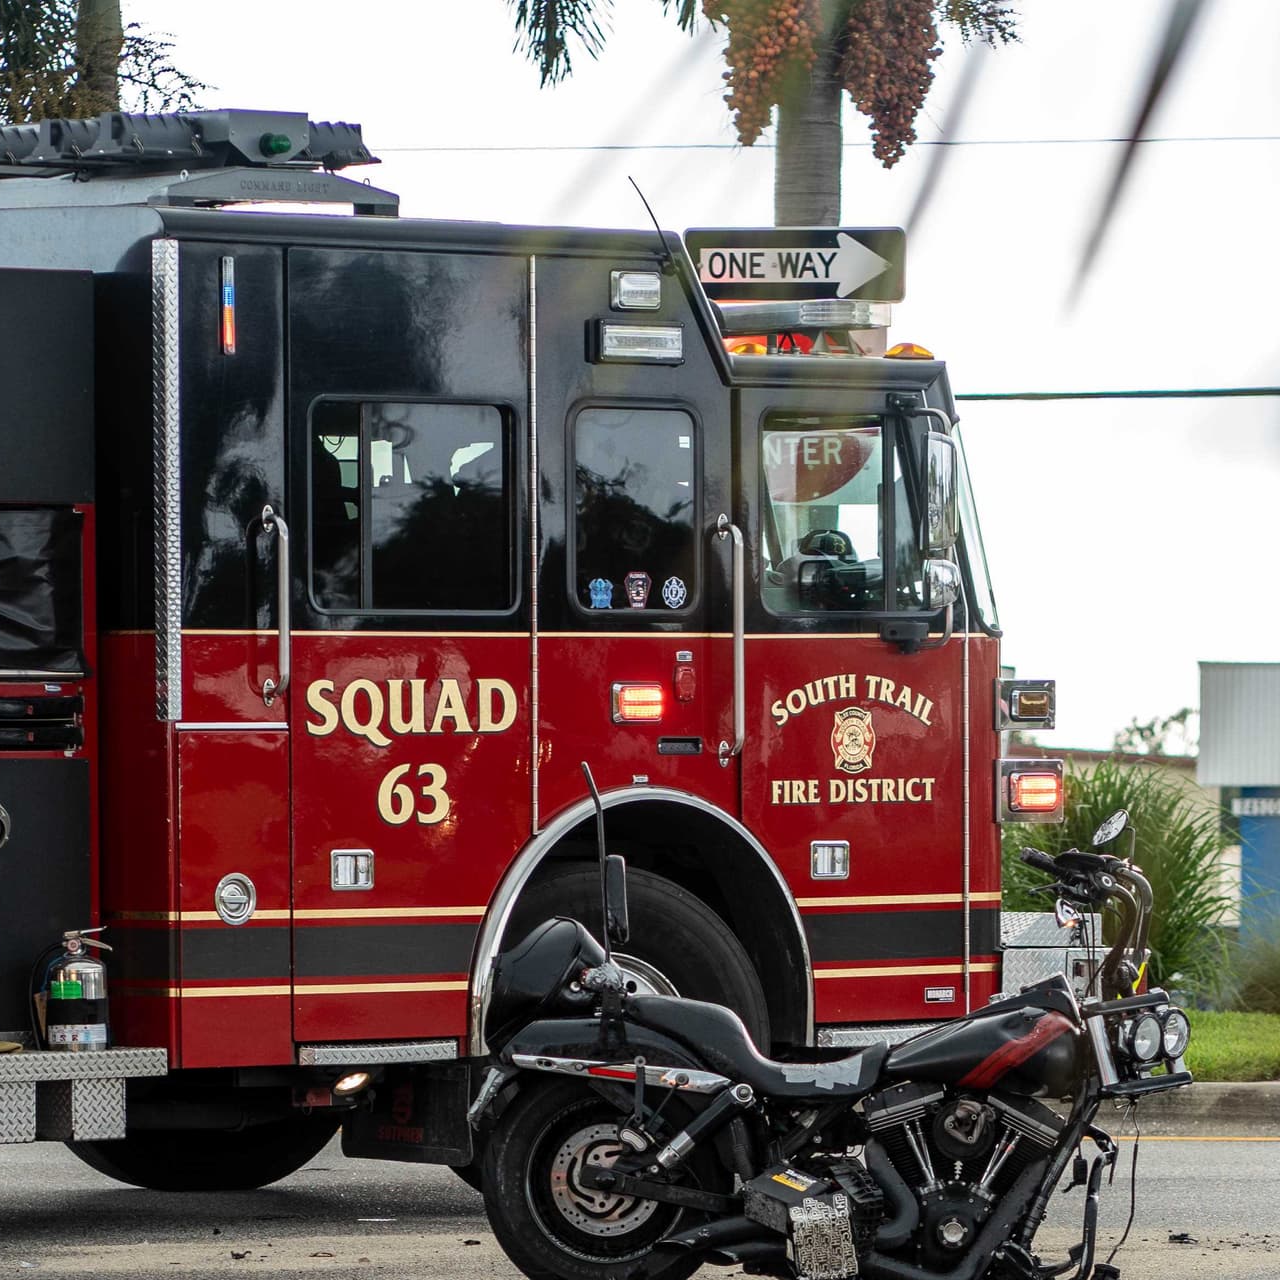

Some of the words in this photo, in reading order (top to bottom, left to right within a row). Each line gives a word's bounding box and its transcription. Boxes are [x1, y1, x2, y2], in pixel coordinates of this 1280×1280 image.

[708, 251, 765, 278] ONE
[777, 251, 838, 279] WAY
[763, 437, 842, 465] NTER
[305, 678, 518, 747] SQUAD
[771, 673, 856, 727] SOUTH
[865, 674, 934, 727] TRAIL
[377, 762, 451, 826] 63
[771, 779, 821, 805] FIRE
[828, 777, 936, 804] DISTRICT
